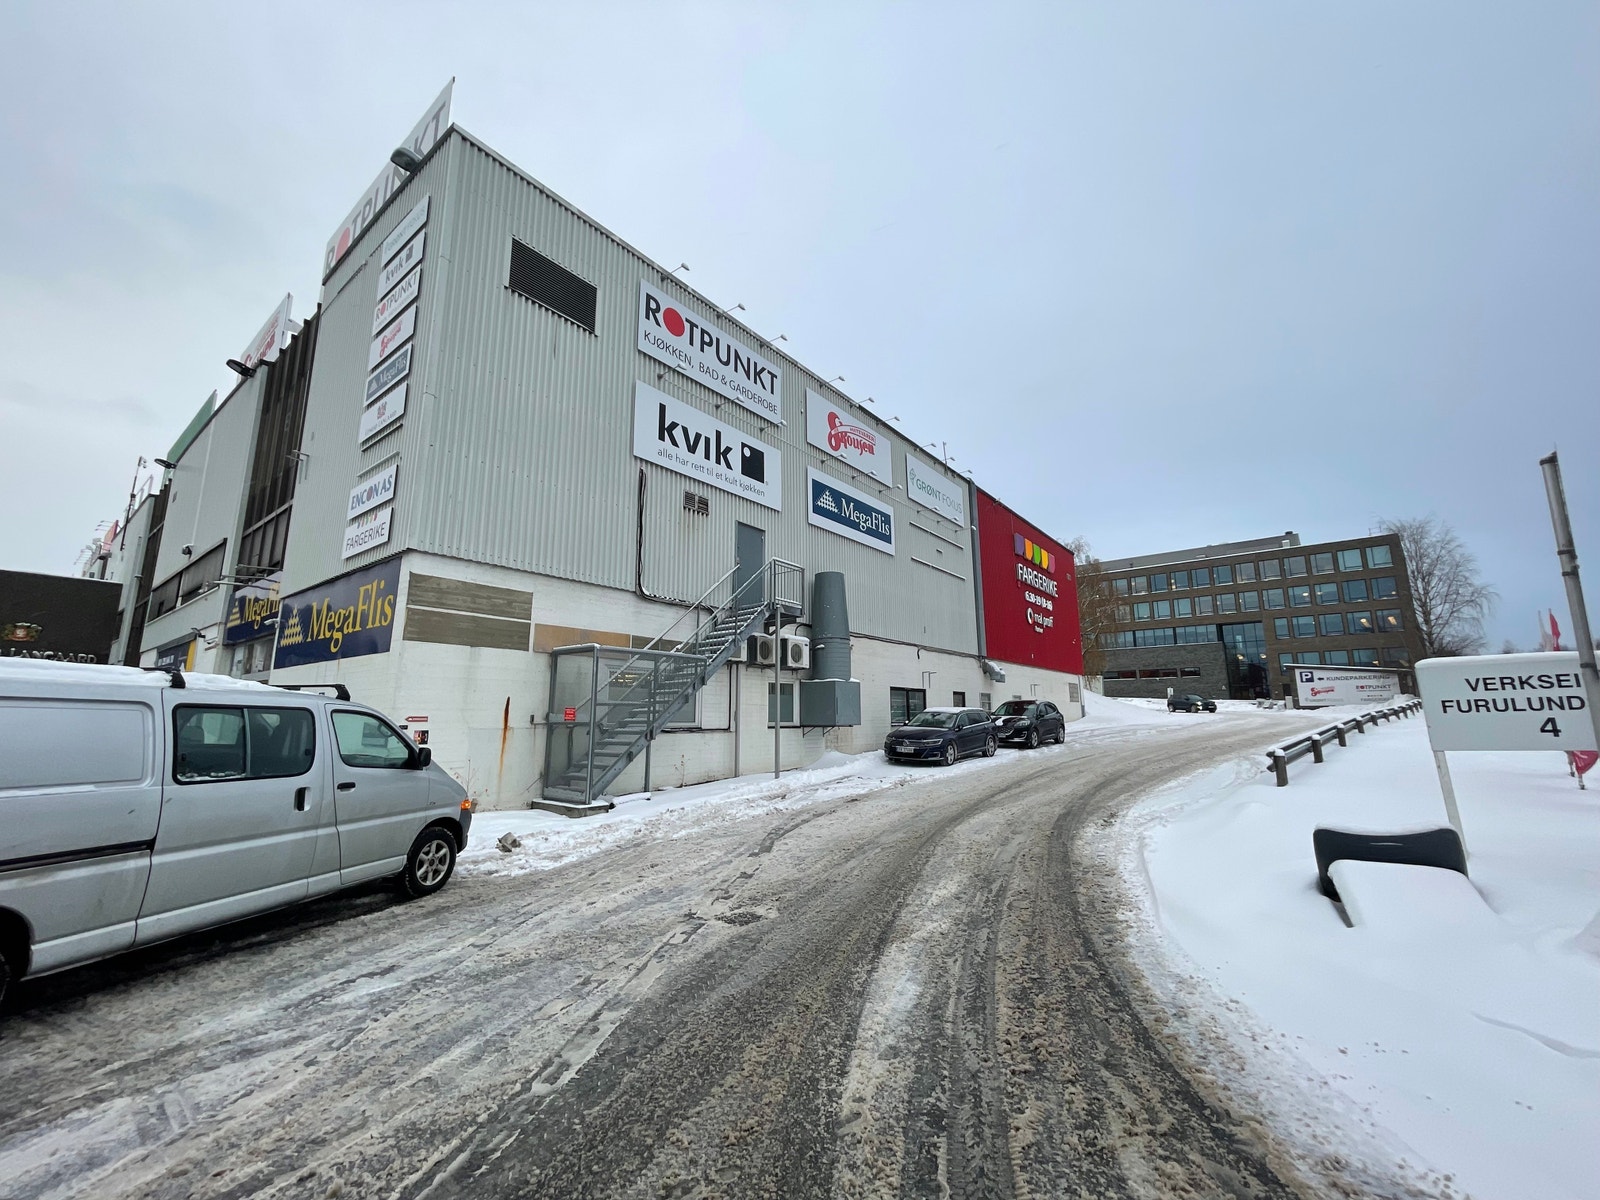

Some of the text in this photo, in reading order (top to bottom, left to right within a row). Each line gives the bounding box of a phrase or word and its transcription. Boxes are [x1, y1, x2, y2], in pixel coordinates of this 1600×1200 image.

[376, 270, 418, 322] ROTPUNKT
[644, 292, 778, 396] ROTPUNKT
[643, 329, 778, 416] KJØKKEN, BAD & GARDEROBE
[658, 402, 734, 471] kvik
[380, 474, 393, 495] AS
[657, 448, 765, 497] alle har rett til et kult kjøkken
[916, 478, 962, 514] GRØNT FOKUS
[841, 498, 890, 536] MegaFlis
[345, 521, 387, 552] FARGERIKE
[1017, 562, 1058, 598] FARGERIKE
[306, 578, 394, 653] MegaFlis
[1441, 695, 1585, 714] FURULUND
[1540, 717, 1561, 737] 4
